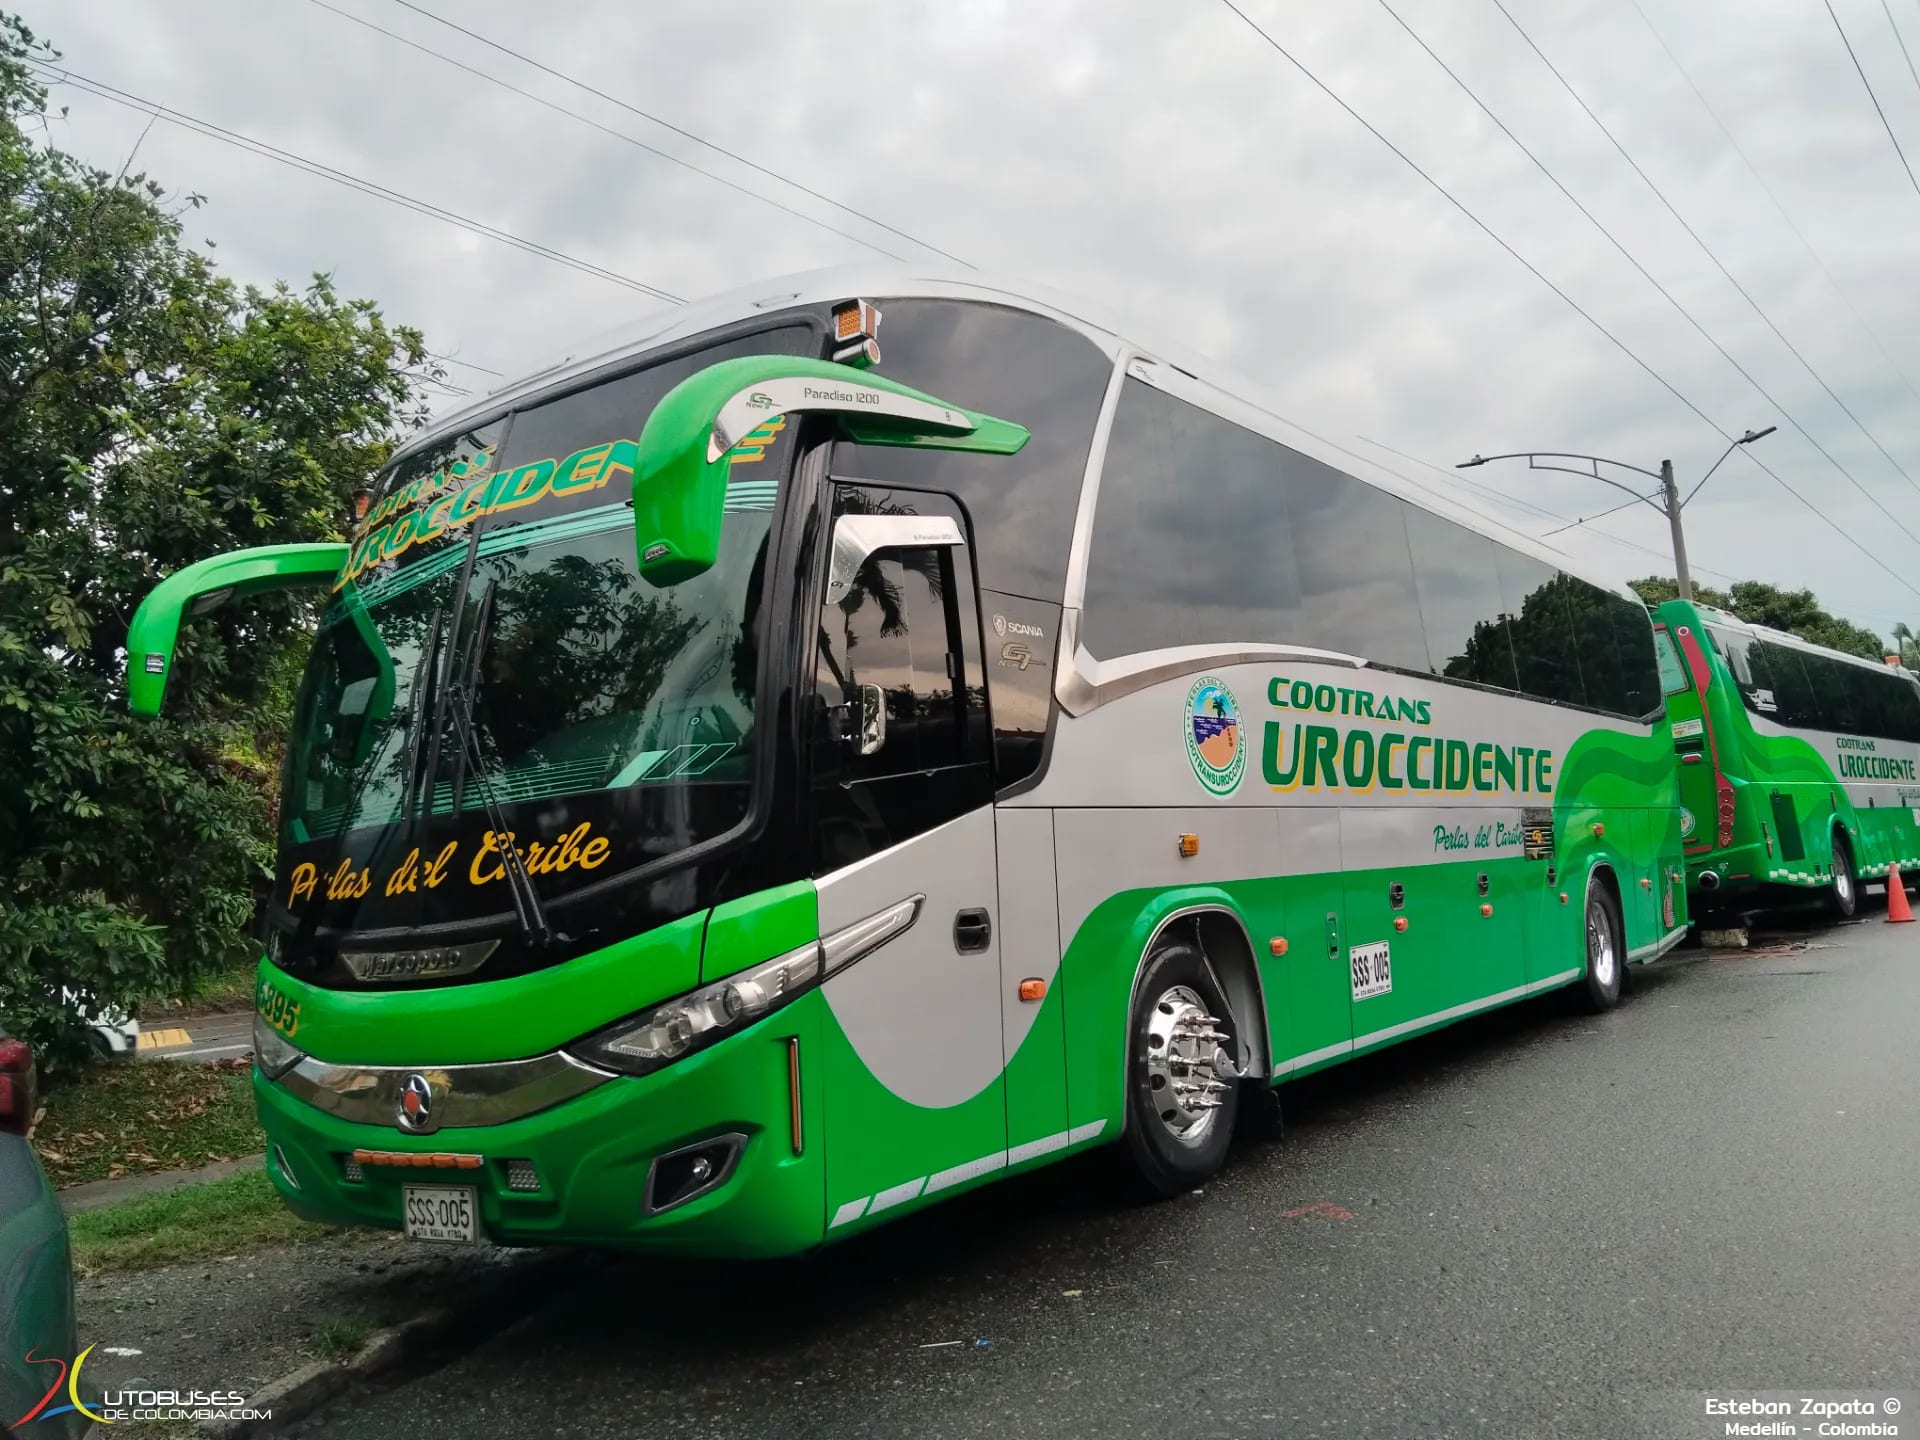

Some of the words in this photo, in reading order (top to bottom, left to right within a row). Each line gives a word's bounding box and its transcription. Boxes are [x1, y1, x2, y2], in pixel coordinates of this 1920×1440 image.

[804, 387, 852, 402] Paradiso
[855, 391, 880, 405] 1200
[333, 414, 786, 592] UROCCIDENE
[1007, 621, 1044, 638] SCANIA
[1267, 677, 1432, 727] COOTRANS
[1262, 720, 1553, 798] UROCCIDENTE
[1836, 738, 1876, 752] COOTRANS
[1838, 753, 1916, 780] UROCCIDENTE
[1433, 825, 1469, 853] Perlas
[1474, 825, 1492, 848] del
[287, 861, 372, 911] Plas
[361, 950, 463, 979] Marcopolo
[417, 1226, 428, 1237] STA
[429, 1227, 445, 1238] ROSA
